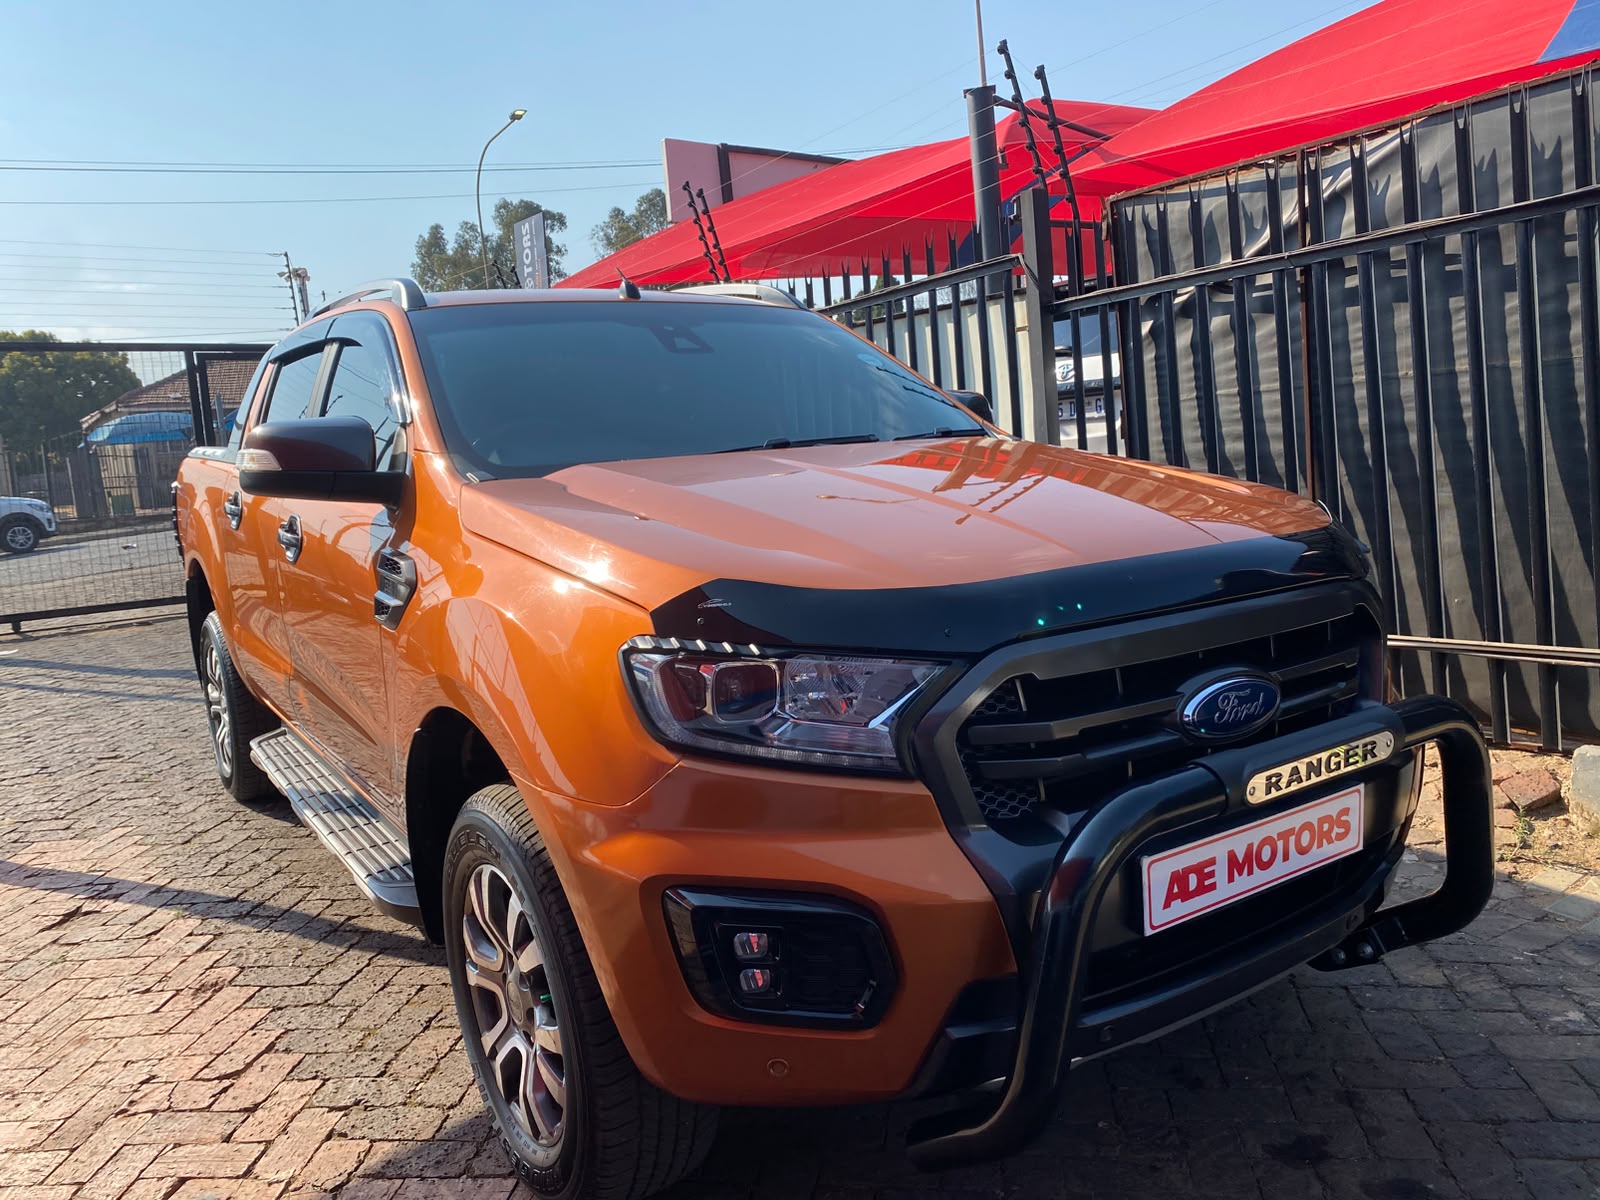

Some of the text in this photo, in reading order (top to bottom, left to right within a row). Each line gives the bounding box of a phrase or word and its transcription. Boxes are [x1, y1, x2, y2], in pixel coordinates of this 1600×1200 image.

[1214, 688, 1265, 723] Ford
[1264, 739, 1378, 796] RANGER
[1162, 807, 1351, 910] ADE MOTORS
